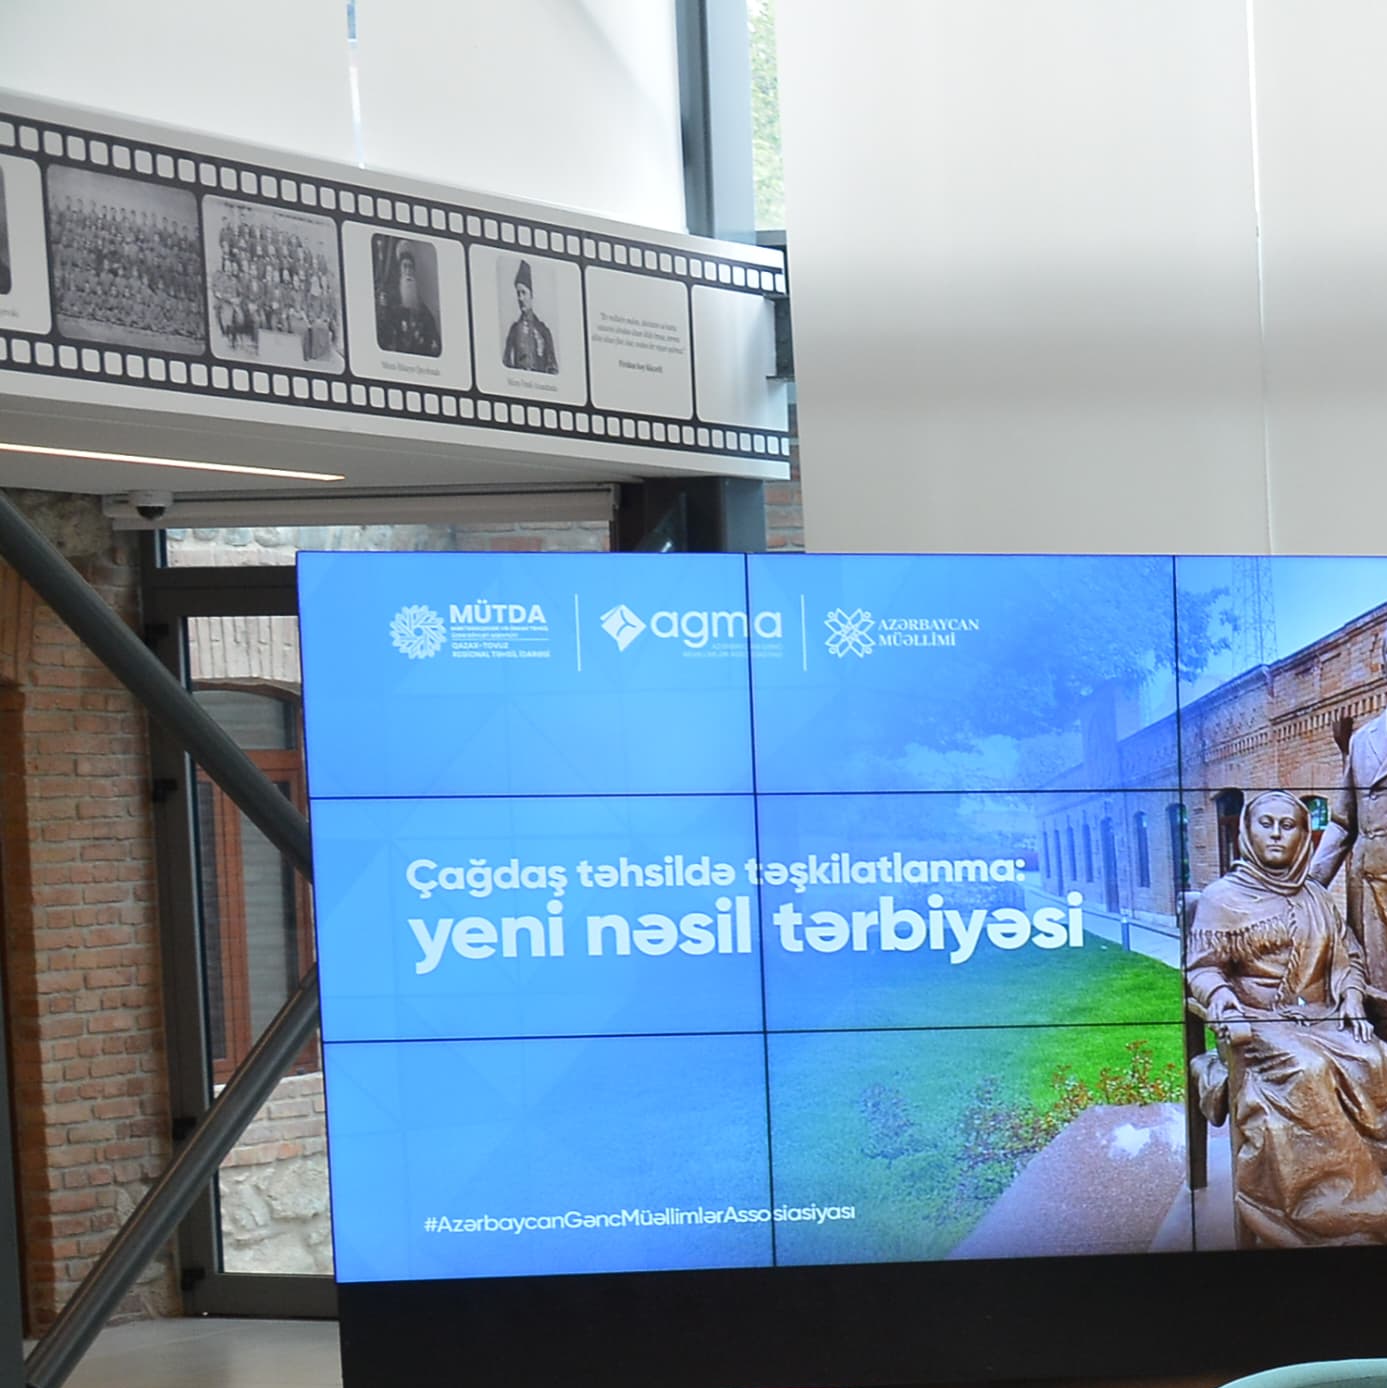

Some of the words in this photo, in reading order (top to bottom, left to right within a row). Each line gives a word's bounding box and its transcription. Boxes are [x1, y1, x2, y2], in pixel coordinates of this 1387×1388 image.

[449, 599, 547, 624] MÜTDA
[879, 618, 979, 631] AZƏRBAYCAN
[650, 611, 782, 649] agma
[879, 631, 956, 646] MÜƏLLİMİ
[406, 858, 568, 899] Çağdaş
[577, 855, 736, 888] təhsildə
[745, 852, 1026, 893] təşkilatlanma:
[408, 899, 565, 974] yeni
[587, 896, 752, 956] nəsil
[773, 891, 1084, 964] tərbiyəsi
[423, 1203, 857, 1235] #AzərbaycanGəncMüəllimlərAssosiasiyası
